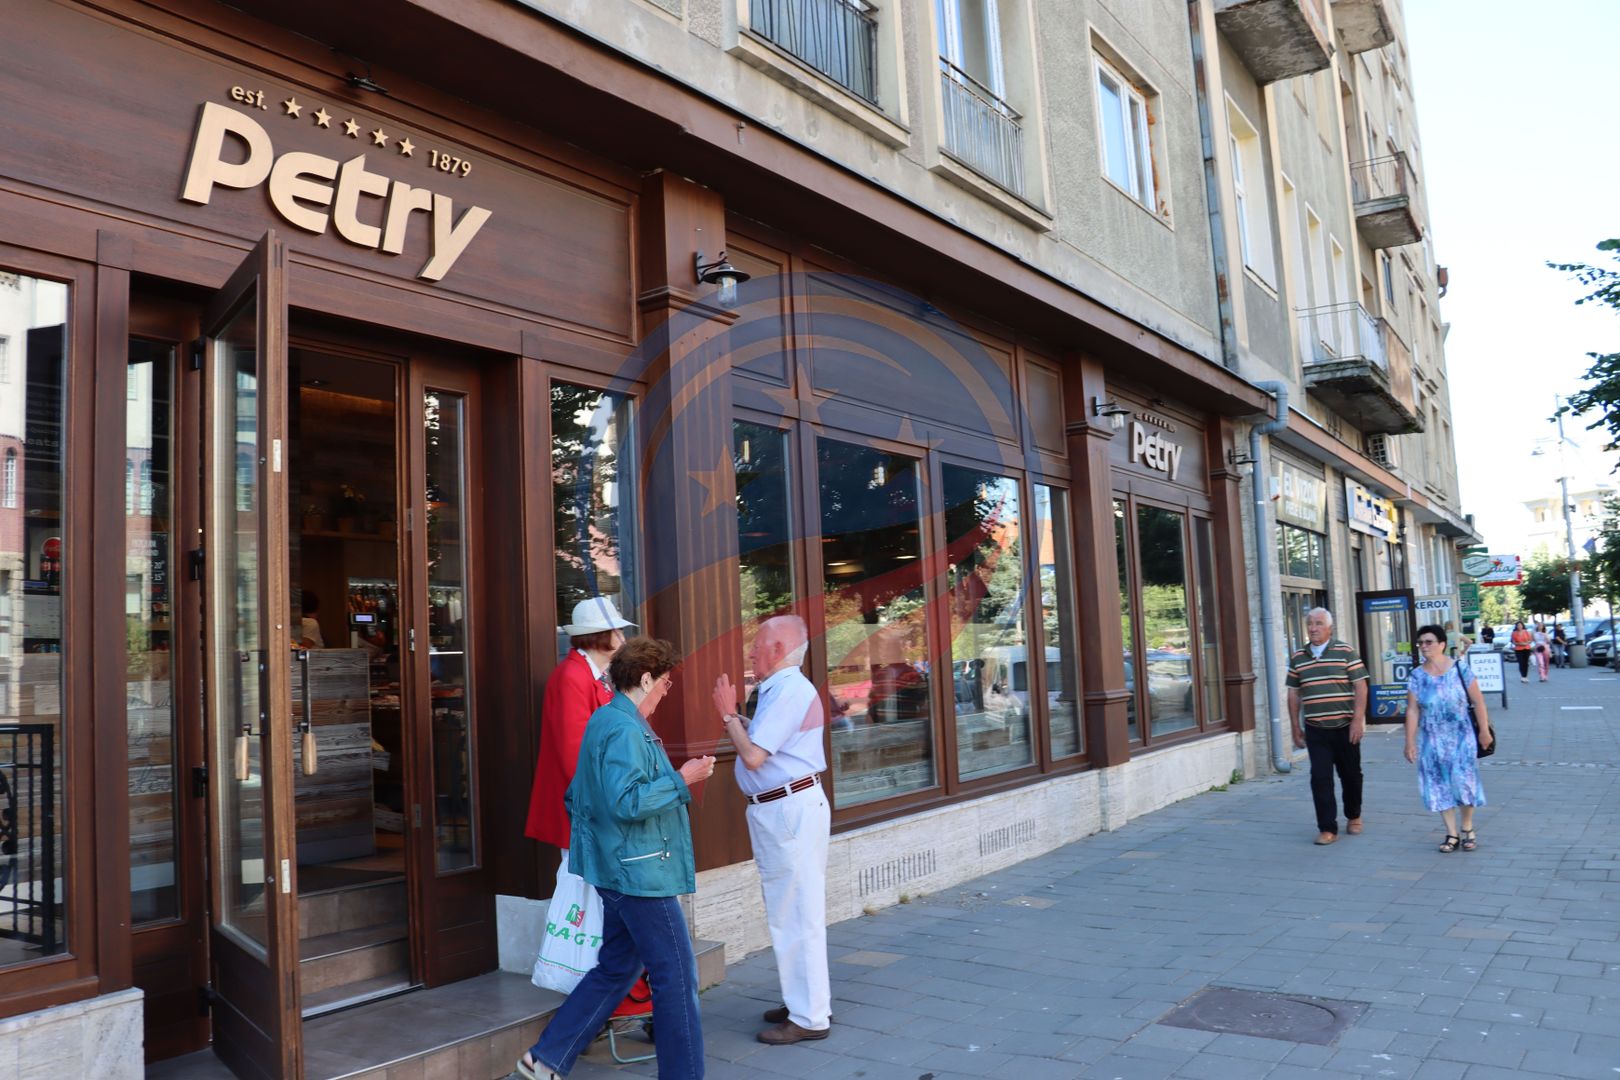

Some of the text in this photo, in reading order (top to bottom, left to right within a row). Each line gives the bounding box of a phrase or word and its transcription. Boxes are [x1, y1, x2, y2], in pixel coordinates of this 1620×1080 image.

[231, 86, 472, 178] est. 1879
[180, 101, 493, 281] Petry
[1130, 421, 1183, 481] Petry
